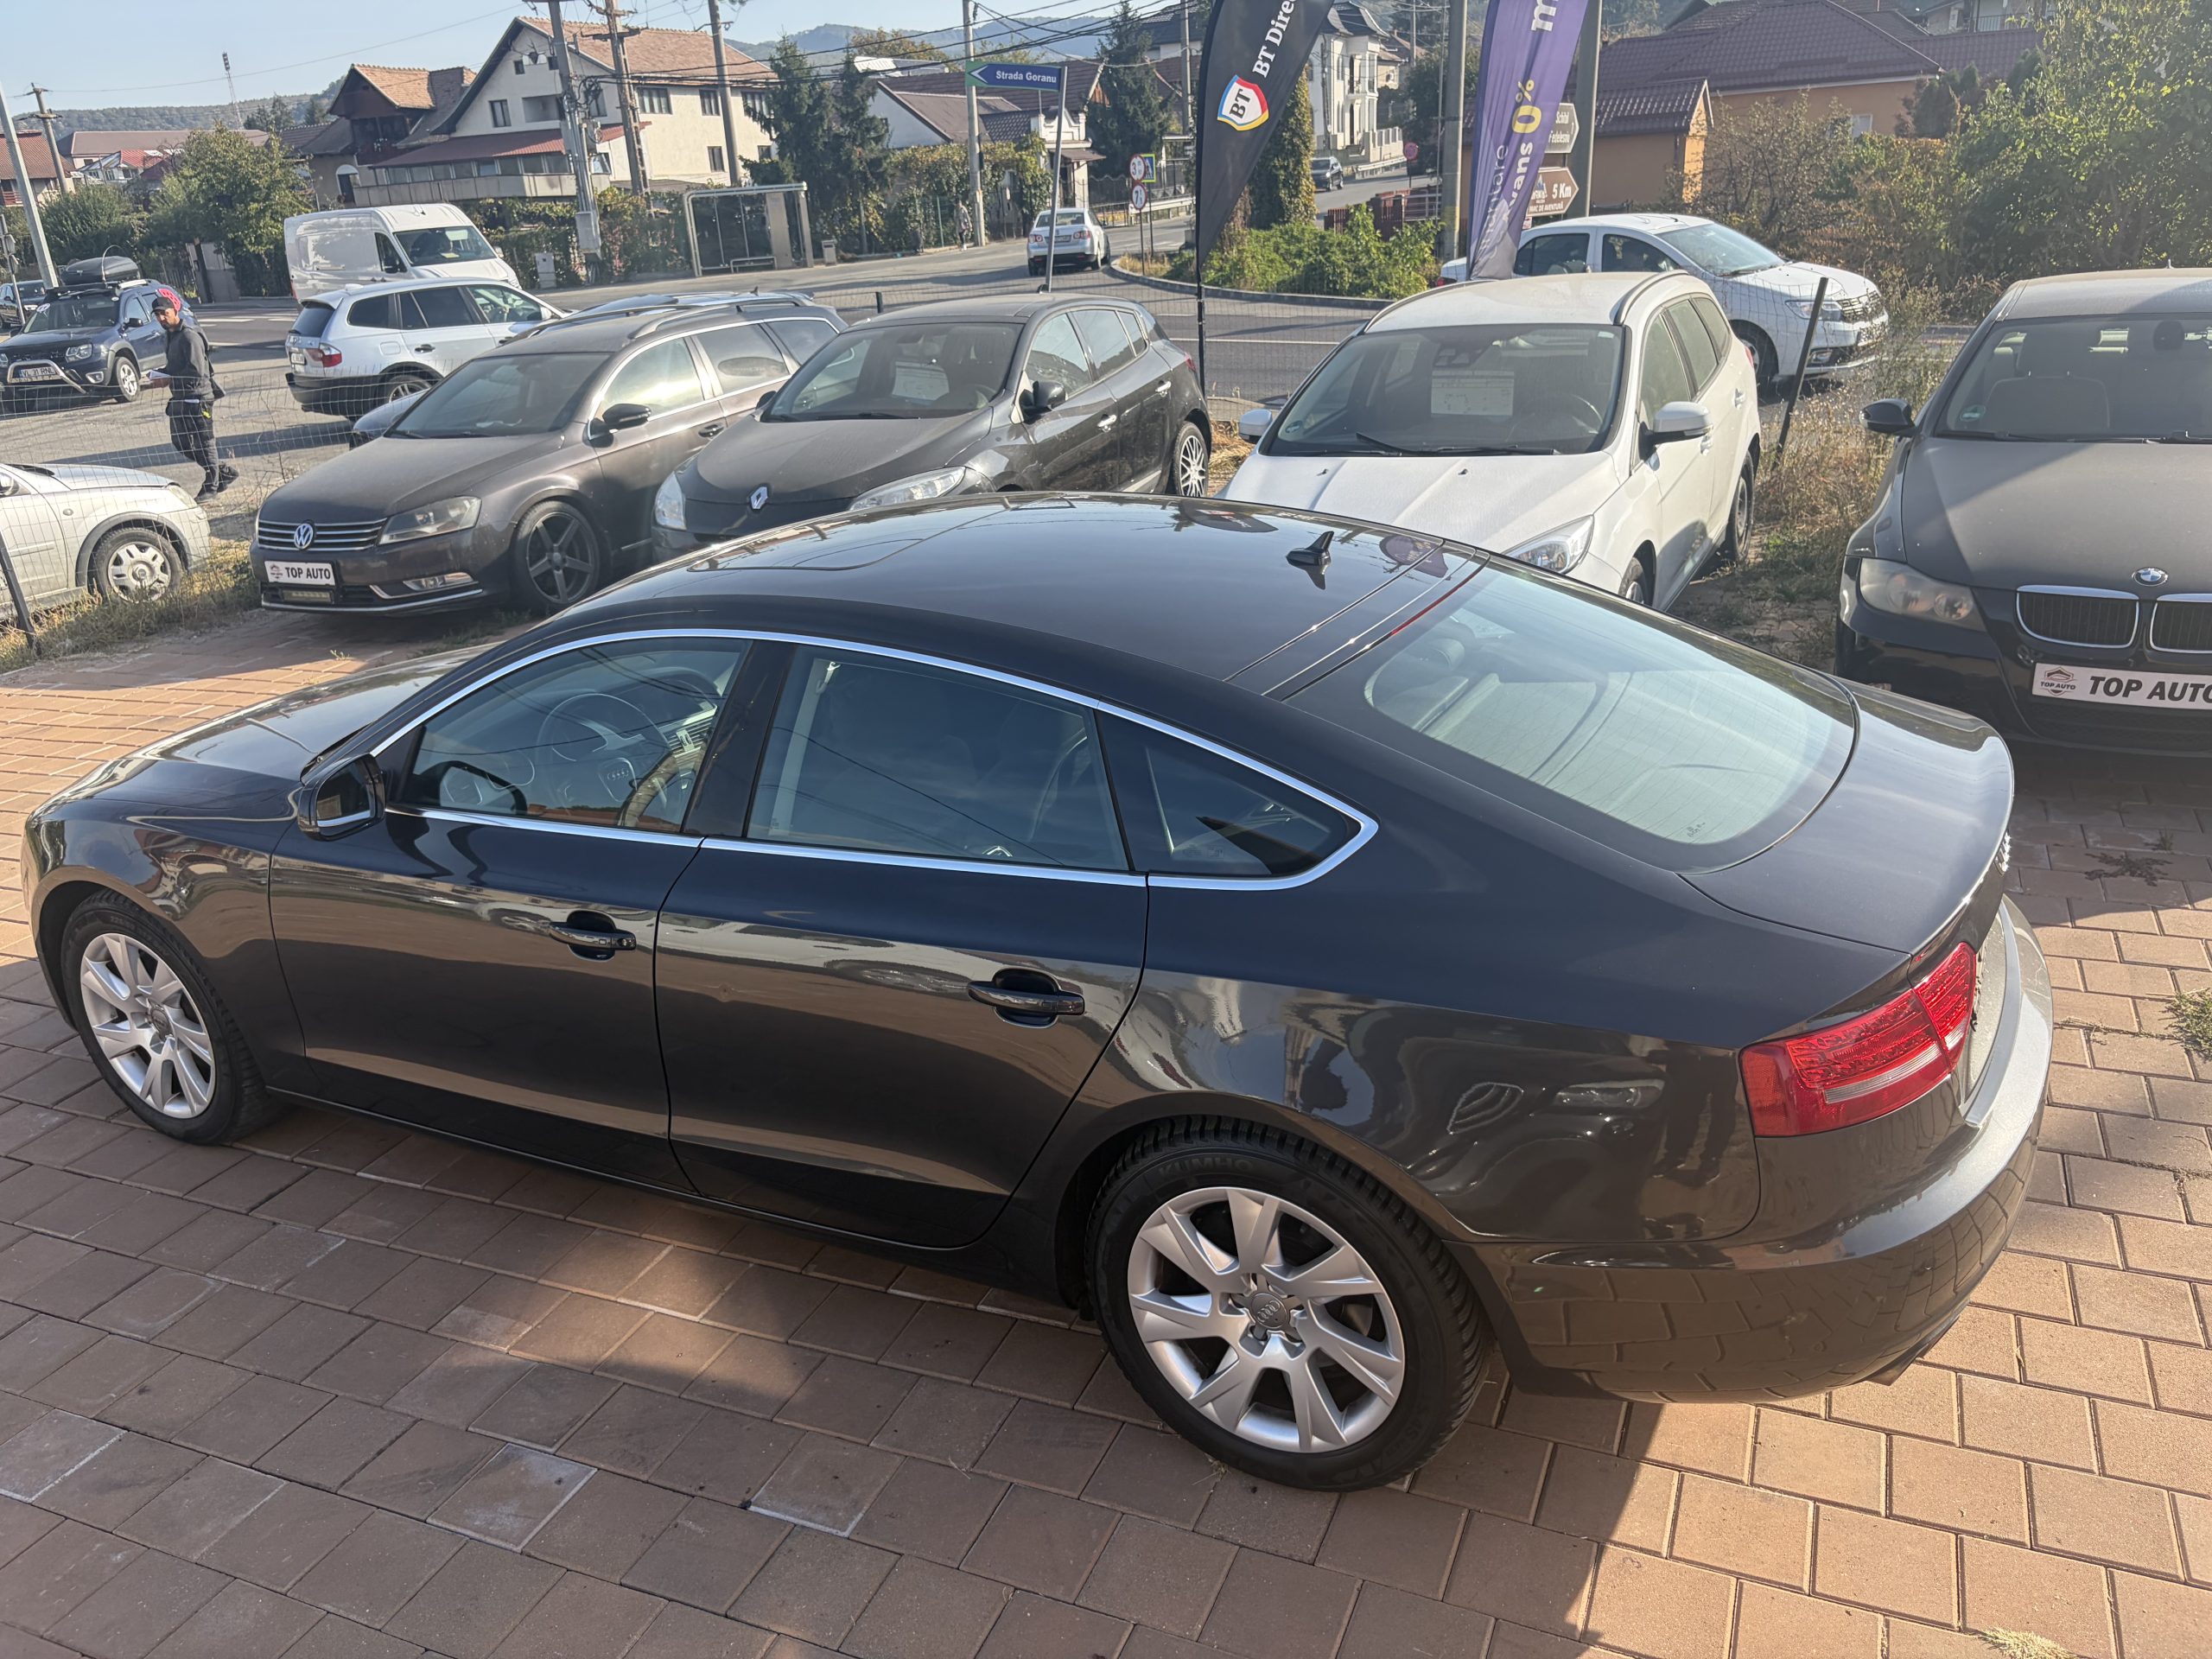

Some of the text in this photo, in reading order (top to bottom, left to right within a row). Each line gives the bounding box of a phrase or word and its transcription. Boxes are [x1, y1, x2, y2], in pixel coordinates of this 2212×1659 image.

[1252, 0, 1296, 78] BT Dire
[995, 70, 1057, 83] Strada Goranu
[1230, 88, 1250, 118] BT
[1552, 183, 1559, 199] 5
[1559, 182, 1572, 199] Km
[285, 567, 331, 580] TOP AUTO
[2040, 681, 2075, 691] TOP AUTO
[2089, 676, 2143, 698] TOP
[1159, 1157, 1253, 1177] KUMHO
